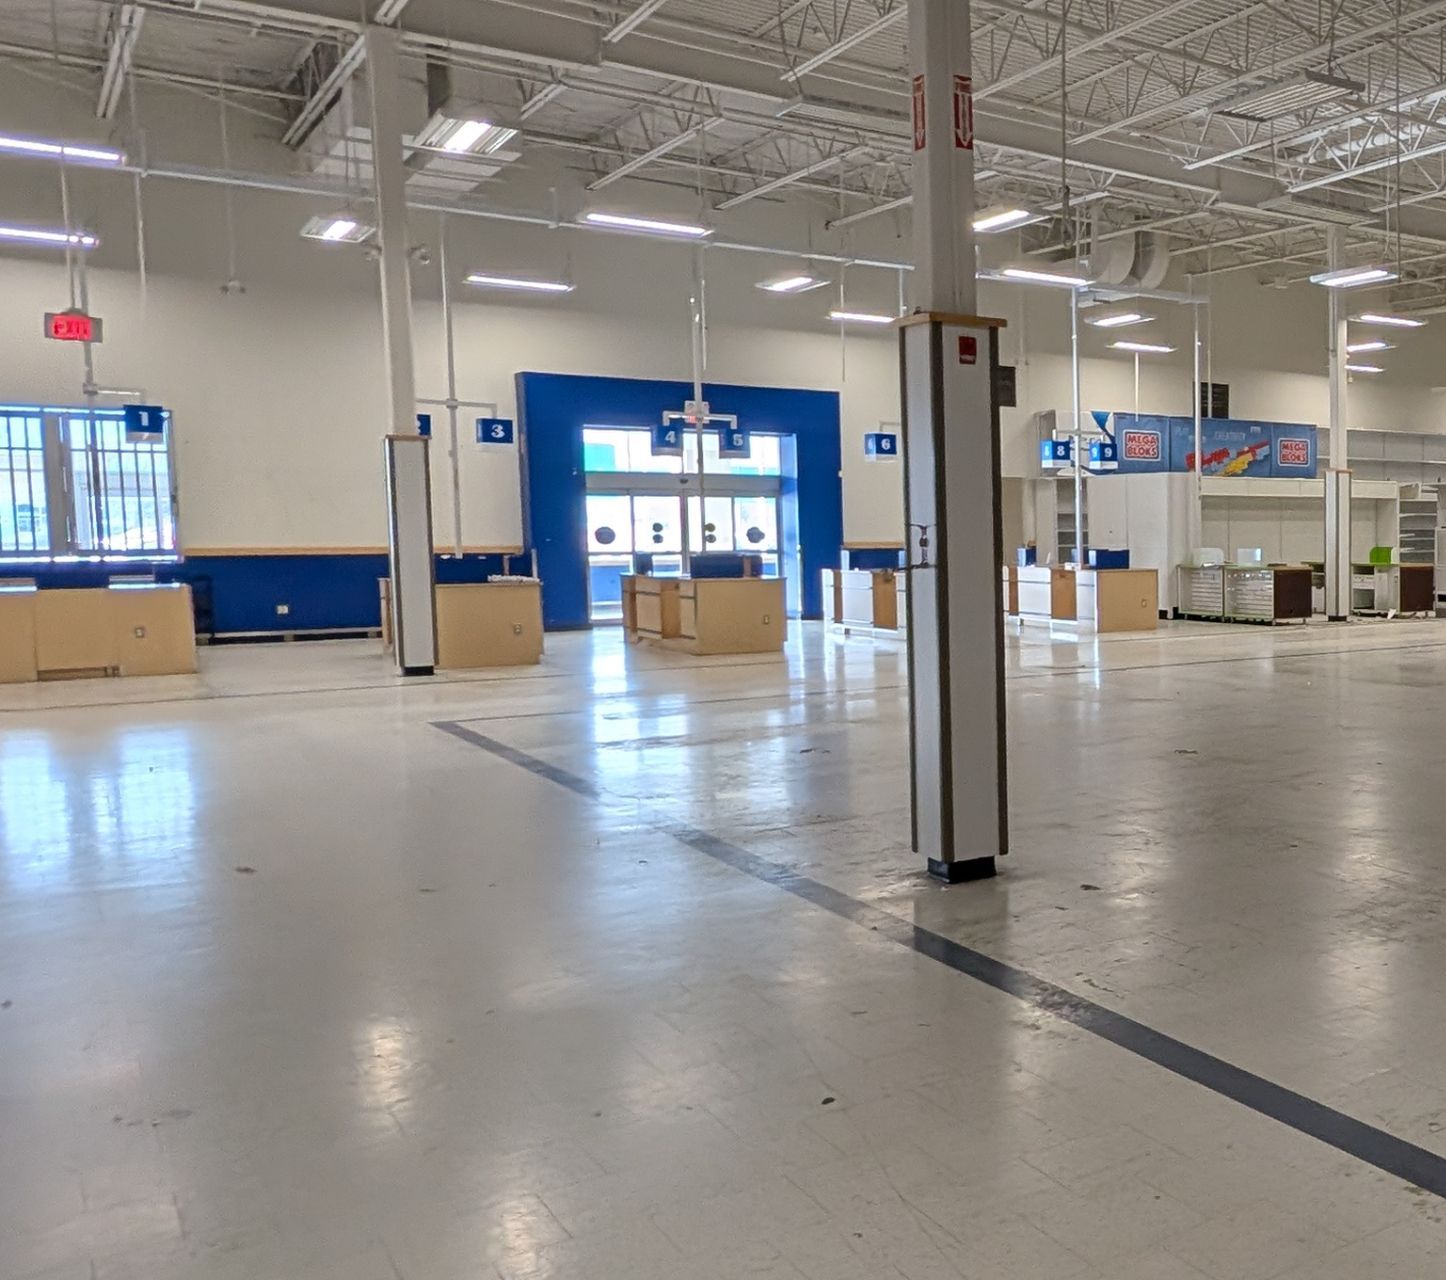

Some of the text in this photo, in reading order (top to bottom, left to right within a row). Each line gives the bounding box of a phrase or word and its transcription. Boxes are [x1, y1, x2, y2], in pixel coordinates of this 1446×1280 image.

[138, 411, 149, 426] 1
[490, 423, 506, 439] 3
[664, 430, 677, 444] 4
[732, 433, 744, 447] 5
[881, 438, 891, 450] 6
[1127, 434, 1157, 445] MEGA
[1056, 445, 1066, 457] 8
[1103, 447, 1113, 458] 9
[1127, 446, 1157, 457] BLOKS
[1281, 442, 1306, 452] MEGA
